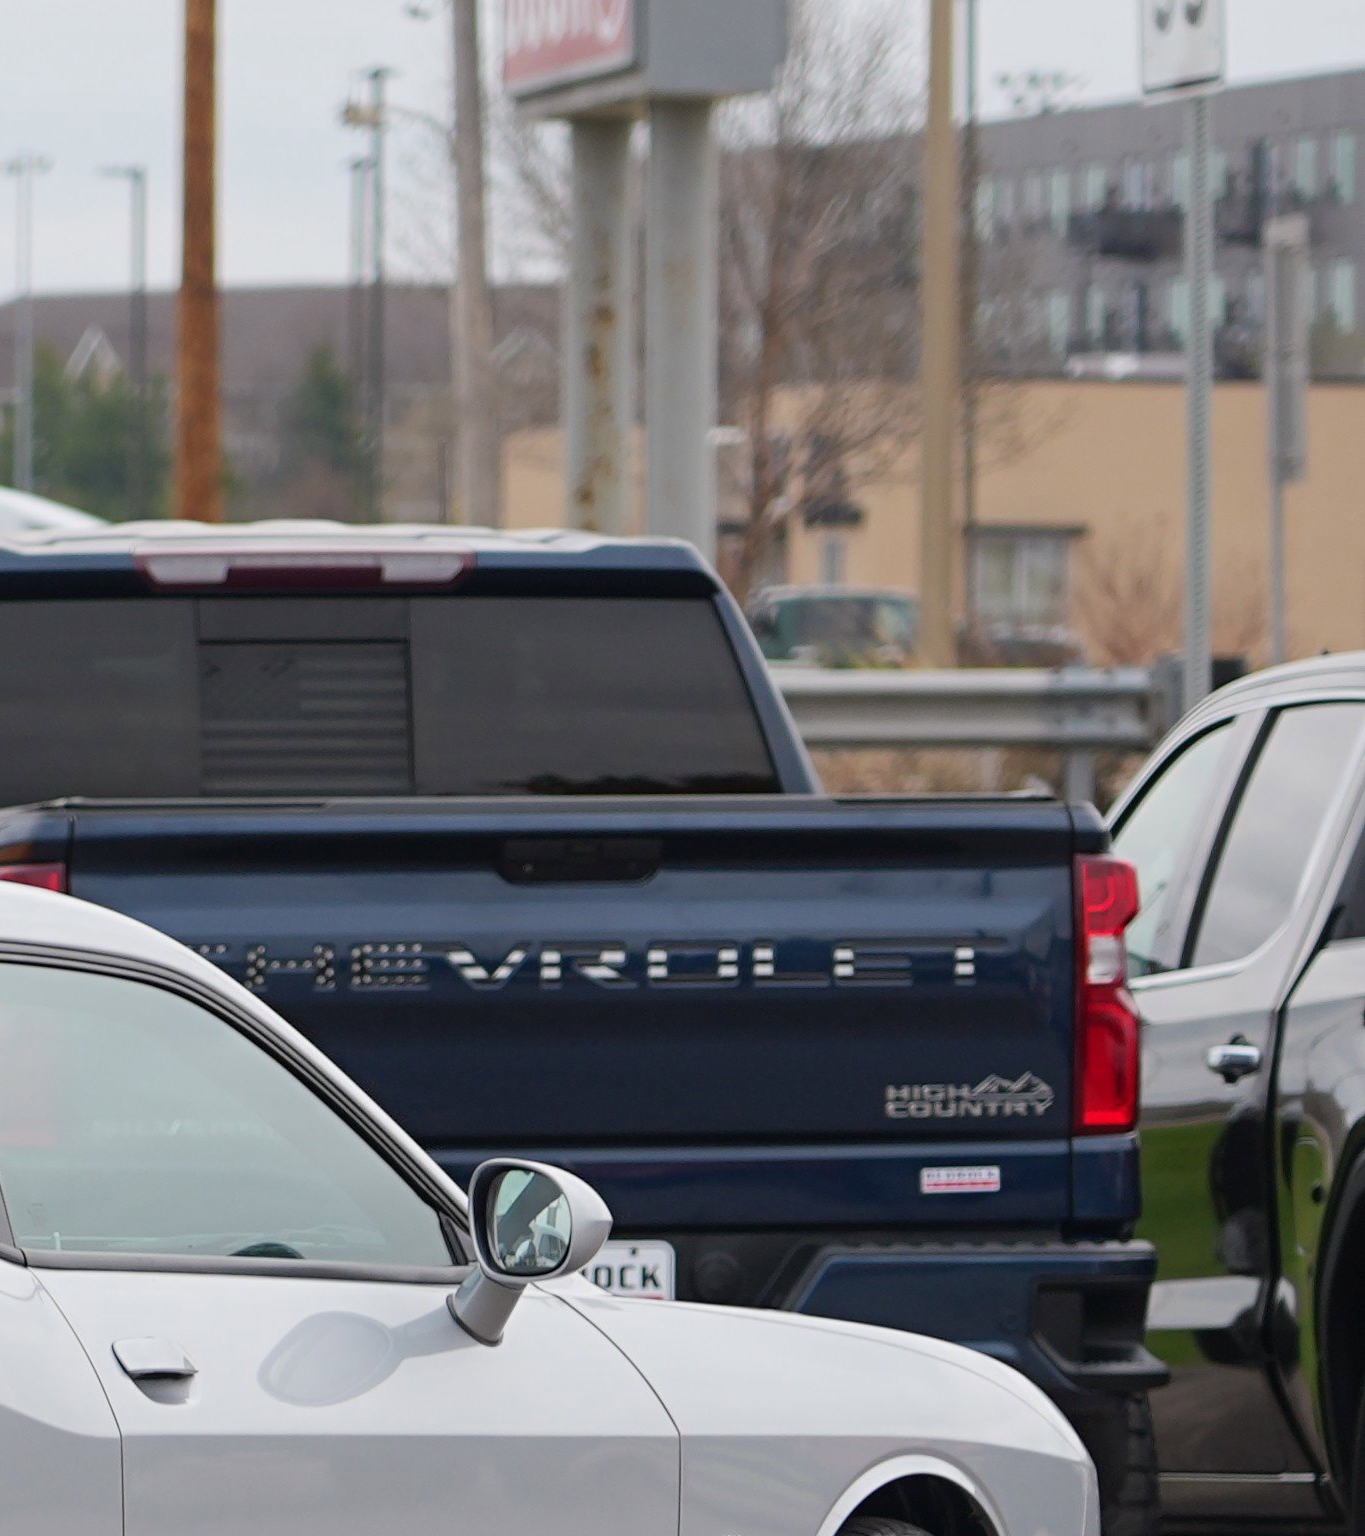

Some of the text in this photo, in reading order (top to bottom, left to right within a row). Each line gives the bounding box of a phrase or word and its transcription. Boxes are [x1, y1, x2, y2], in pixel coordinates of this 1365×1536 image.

[191, 937, 1007, 990] HEVROLET
[885, 1083, 970, 1101] HIGH
[885, 1099, 1054, 1119] COUNTRY
